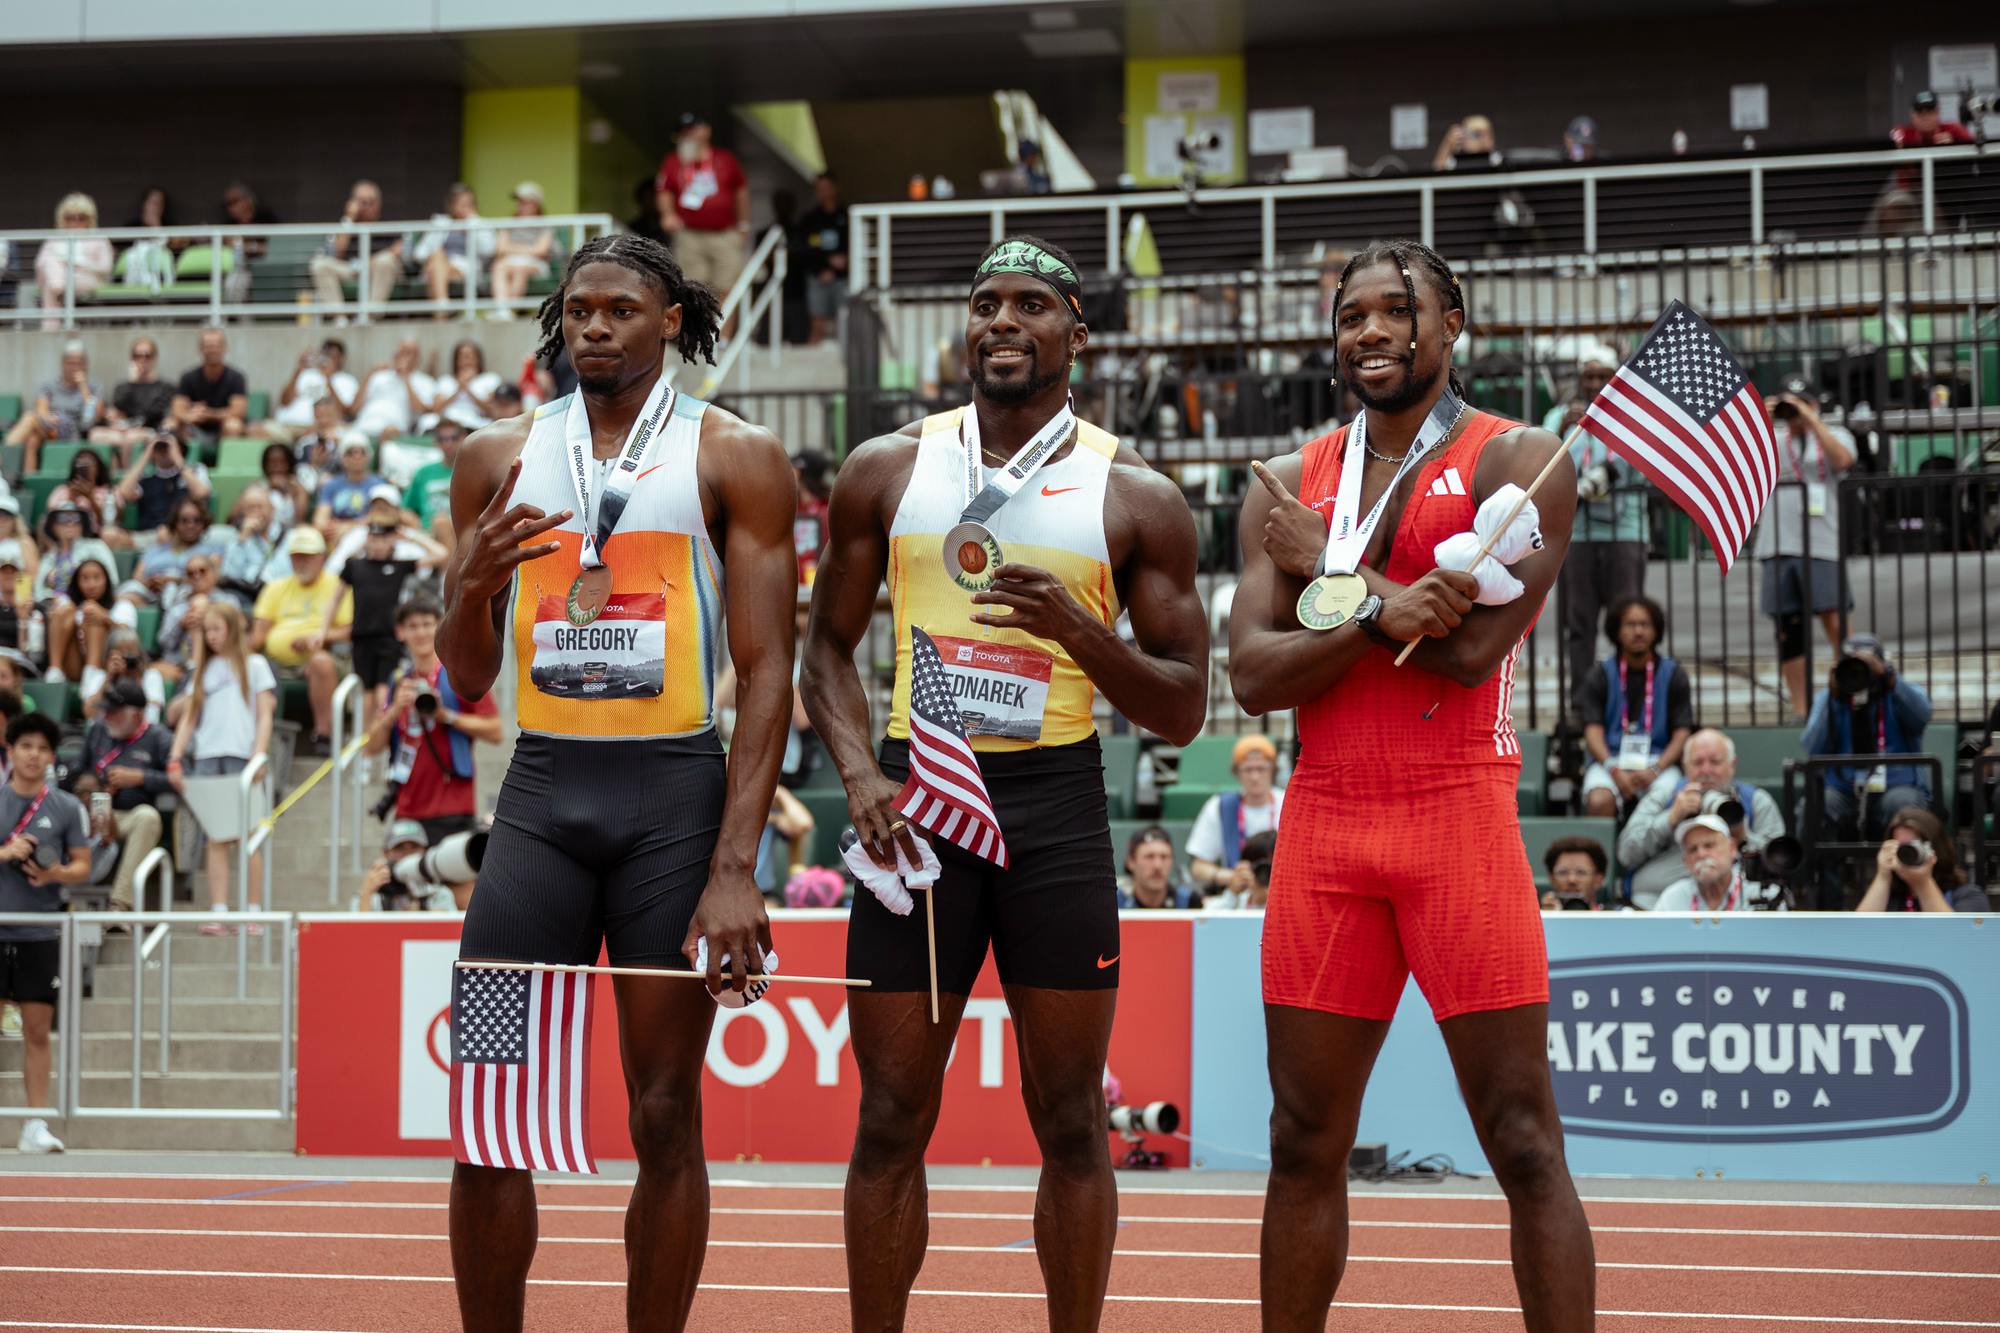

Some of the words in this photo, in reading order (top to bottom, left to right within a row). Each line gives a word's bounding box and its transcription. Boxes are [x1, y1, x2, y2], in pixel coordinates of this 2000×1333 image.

[632, 429, 652, 460] OUTDOOR
[573, 445, 585, 476] OUTDOOR
[1021, 449, 1043, 473] OUTDOOR
[555, 627, 638, 650] GREGORY
[975, 651, 1011, 664] TOYOTA
[947, 673, 1029, 709] DNAREK
[1572, 985, 1846, 1011] DISCOVER
[704, 997, 1107, 1088] OYT
[1547, 1021, 1656, 1073] AKE
[1671, 1022, 1926, 1075] COUNTY
[1588, 1084, 1831, 1109] FLORIDA
